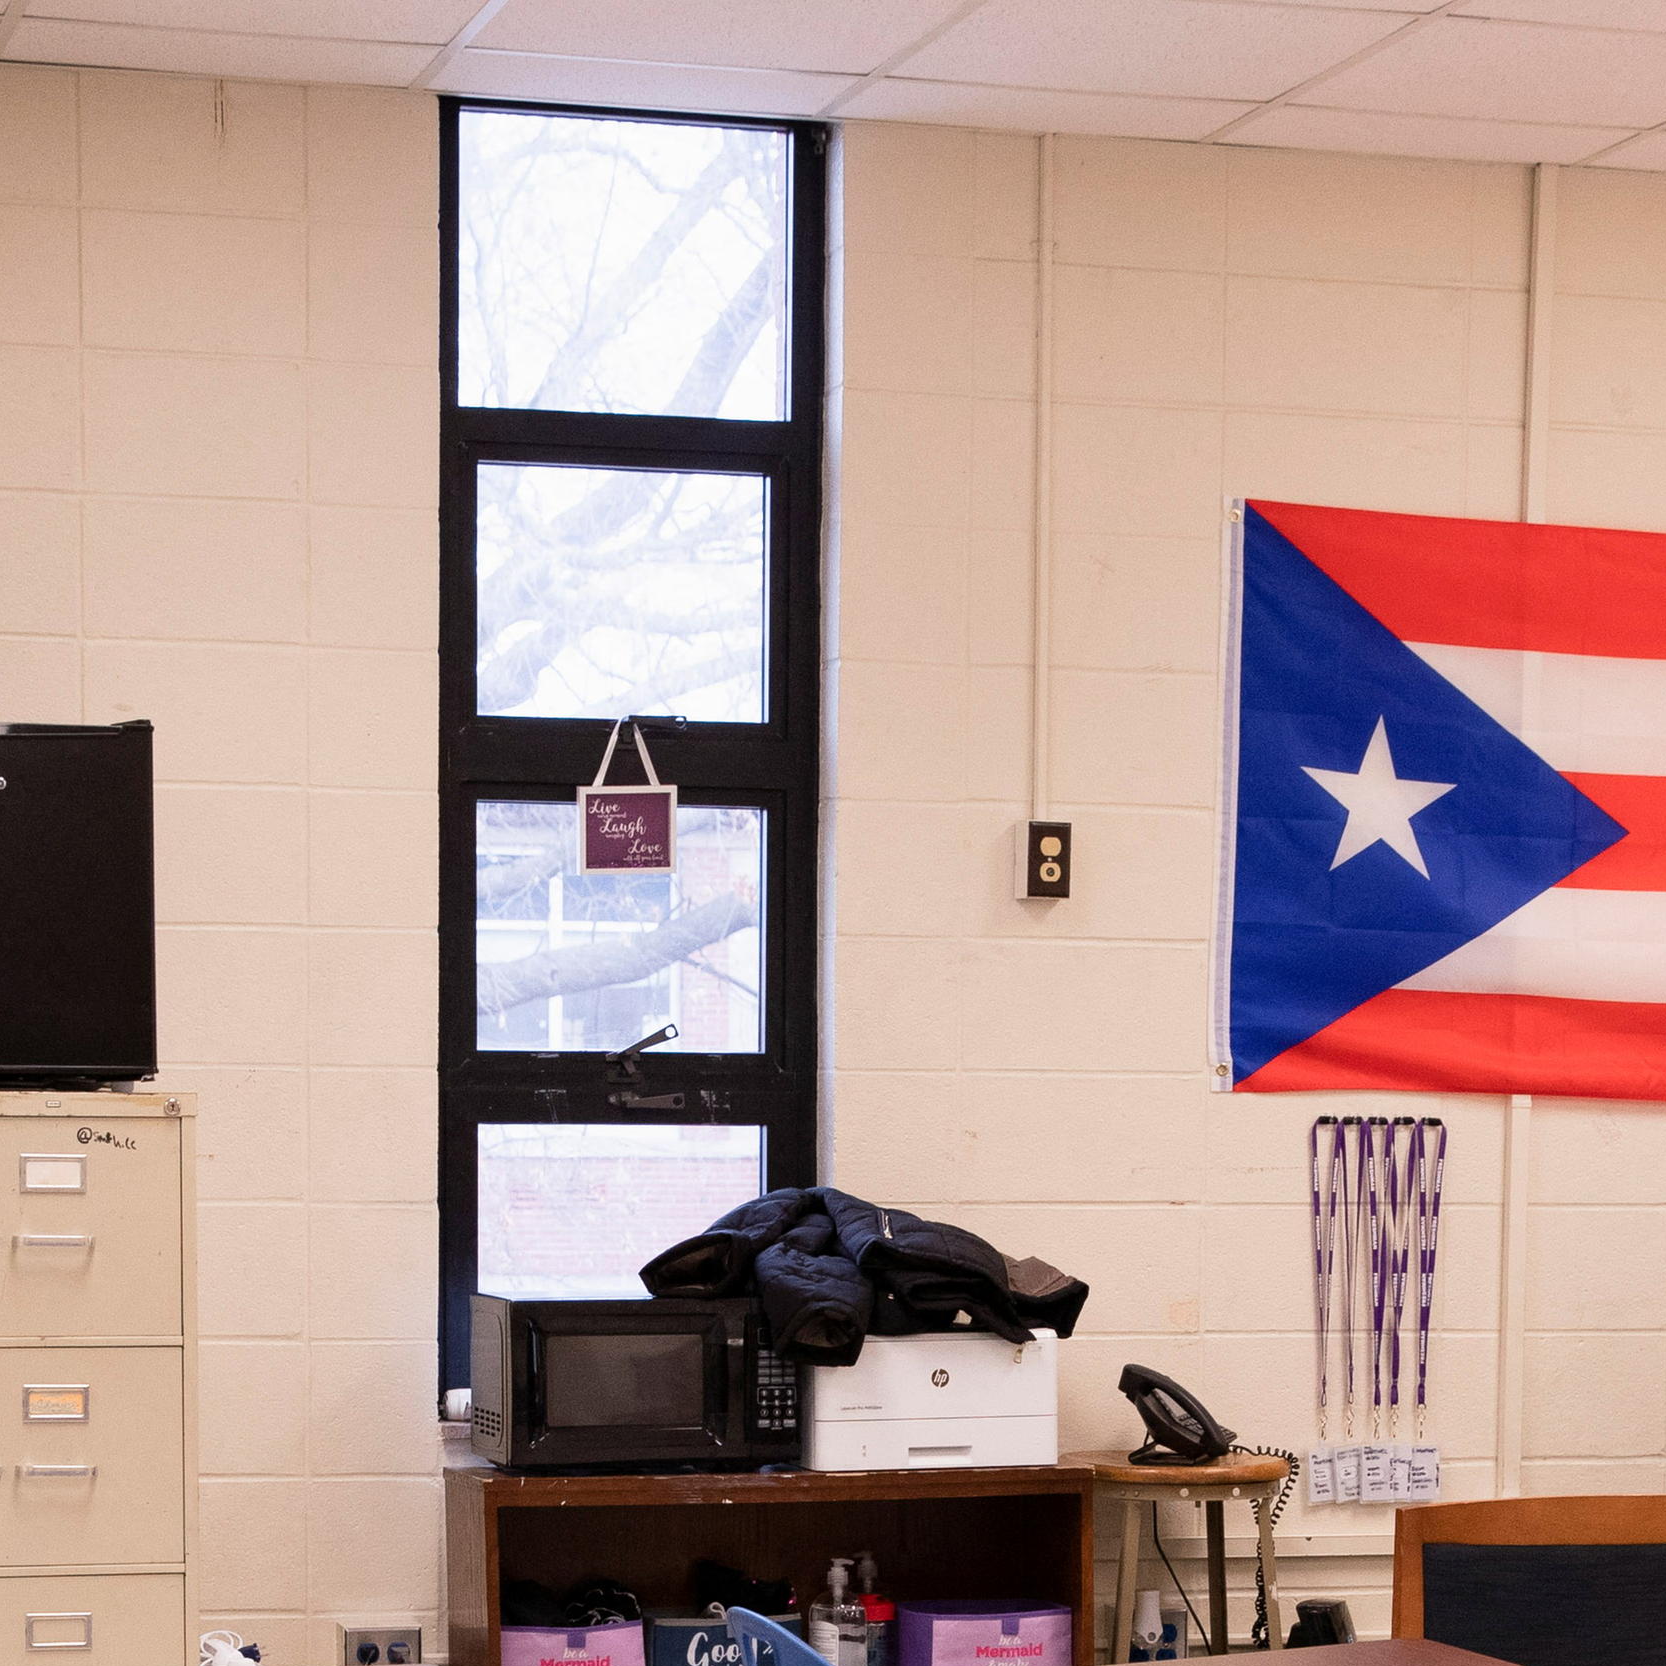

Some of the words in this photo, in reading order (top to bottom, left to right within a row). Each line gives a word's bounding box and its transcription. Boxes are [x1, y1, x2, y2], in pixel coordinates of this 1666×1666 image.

[588, 798, 621, 814] Live
[599, 816, 647, 839] Laugh
[627, 838, 663, 854] Love
[999, 1635, 1013, 1646] be
[563, 1648, 579, 1659] be
[580, 1650, 588, 1658] a
[975, 1643, 1043, 1658] Mermaid
